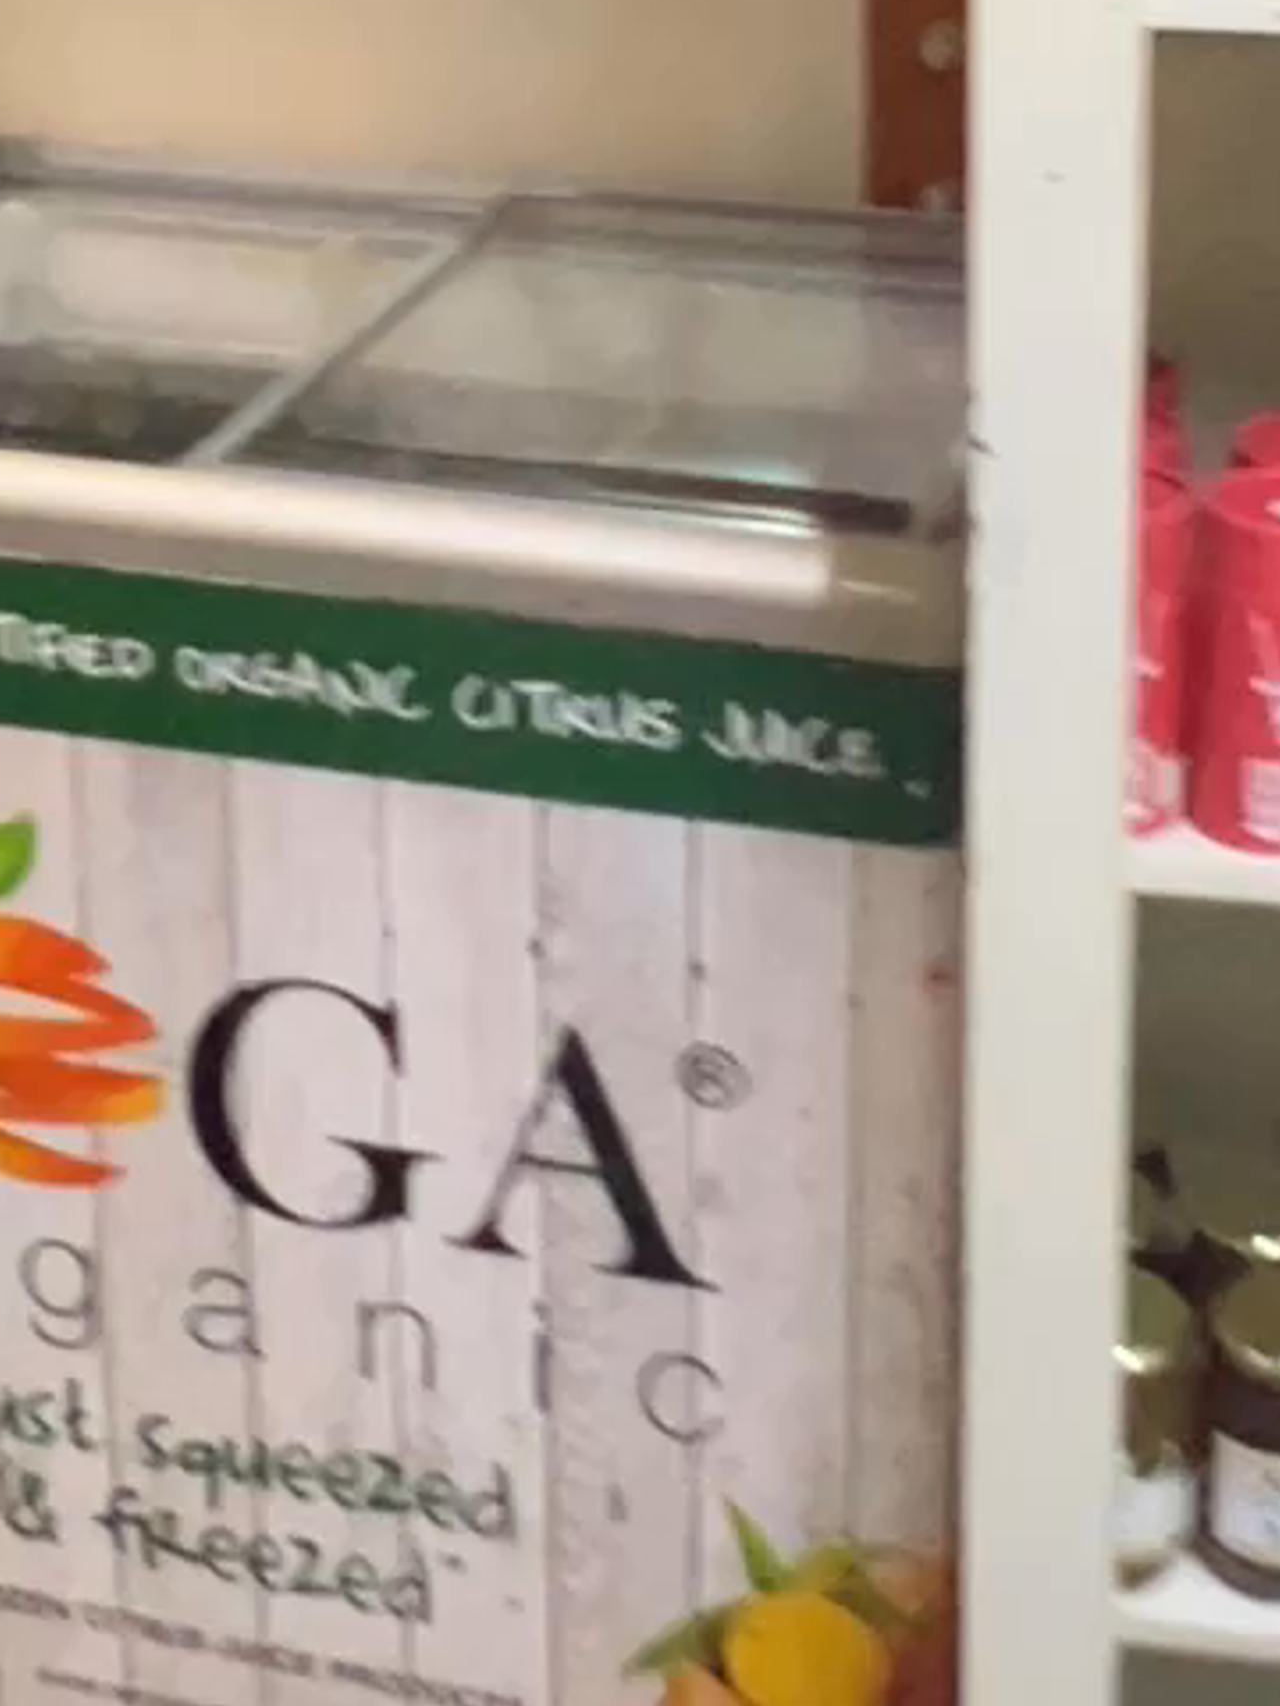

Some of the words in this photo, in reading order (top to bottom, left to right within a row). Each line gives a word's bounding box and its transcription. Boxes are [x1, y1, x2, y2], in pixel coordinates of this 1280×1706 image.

[172, 645, 431, 724] ORGANIC
[450, 674, 684, 751] CITRUS
[134, 1412, 516, 1543] squeezed
